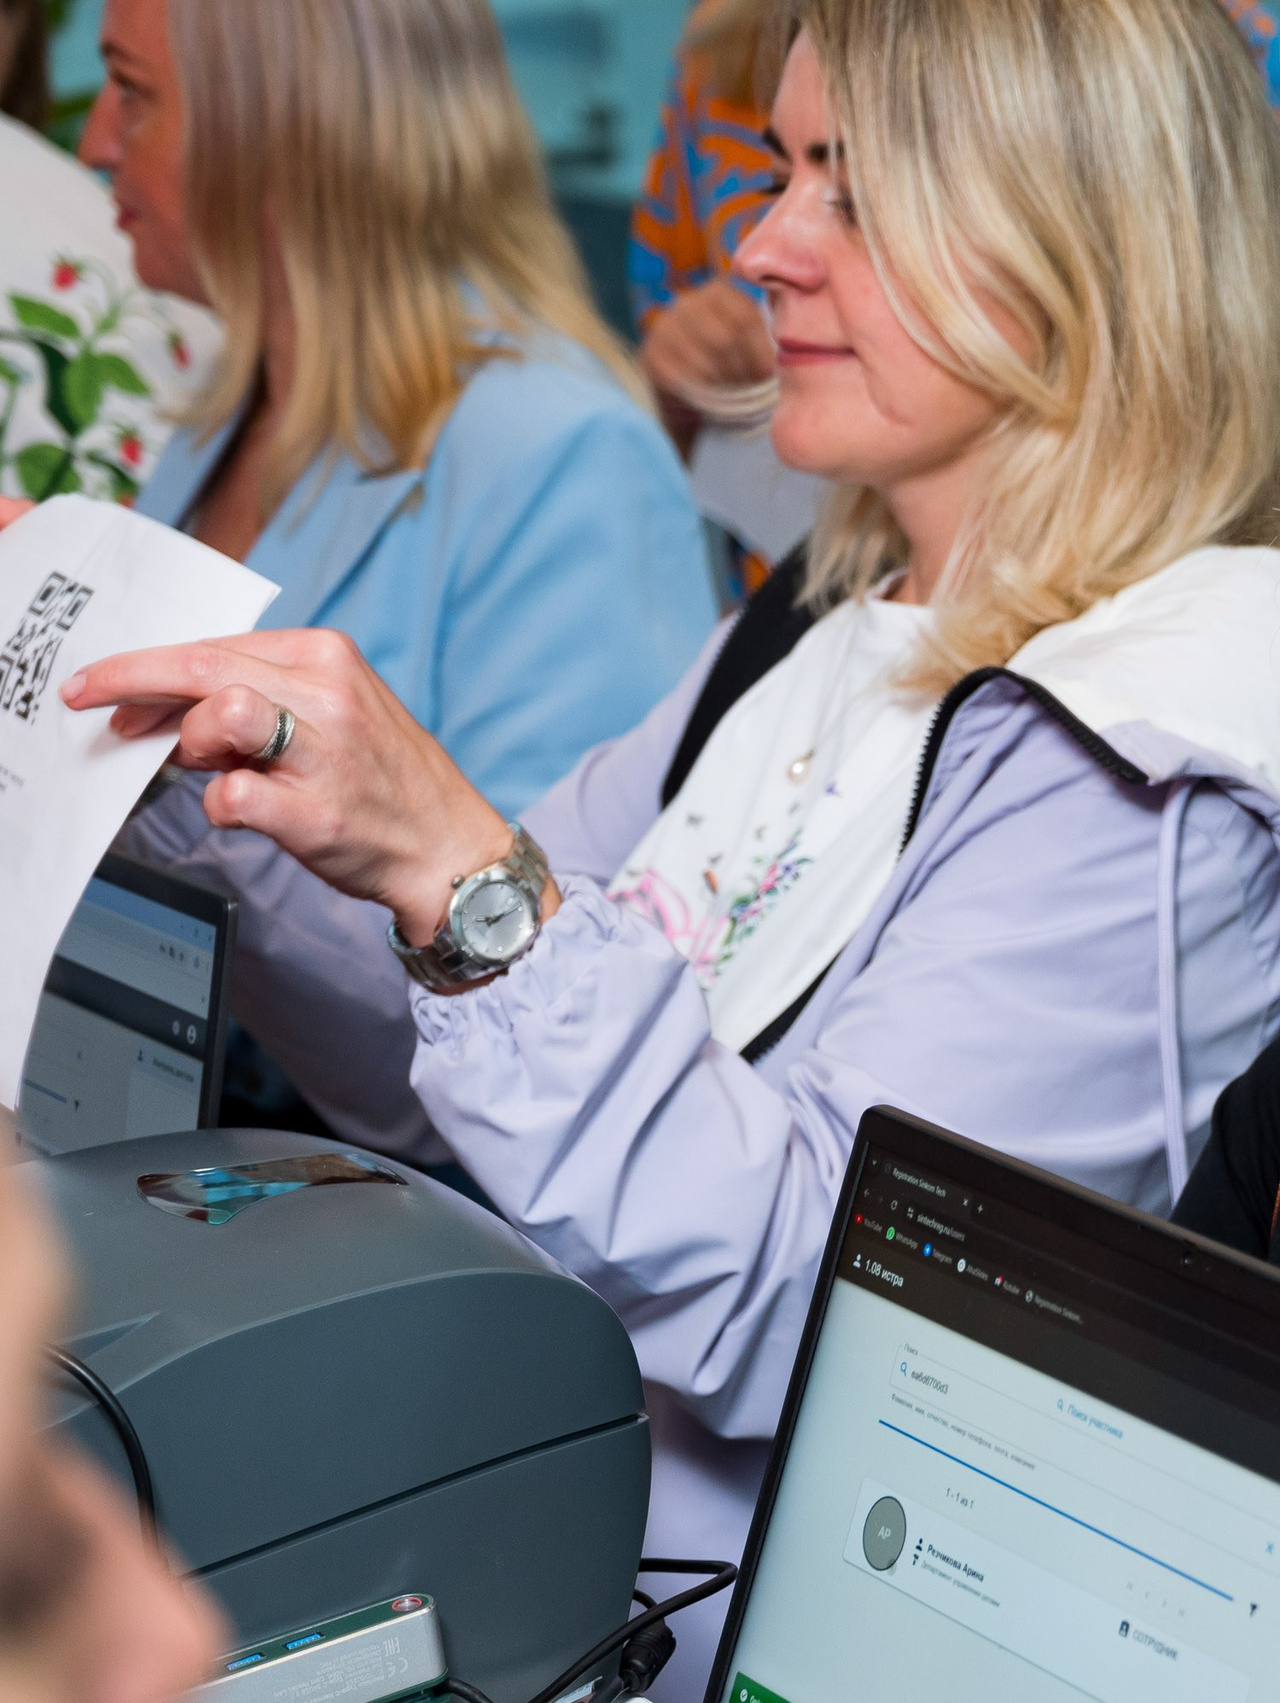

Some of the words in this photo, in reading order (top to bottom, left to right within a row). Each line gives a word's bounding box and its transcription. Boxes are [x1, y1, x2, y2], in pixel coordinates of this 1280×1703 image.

[865, 1259, 882, 1276] 1.08
[881, 1269, 904, 1287] истра
[1068, 1404, 1087, 1422] Поиск
[927, 1544, 961, 1569] Резчикова
[962, 1563, 984, 1582] Арина
[1132, 1629, 1178, 1661] СОТРУДНИК
